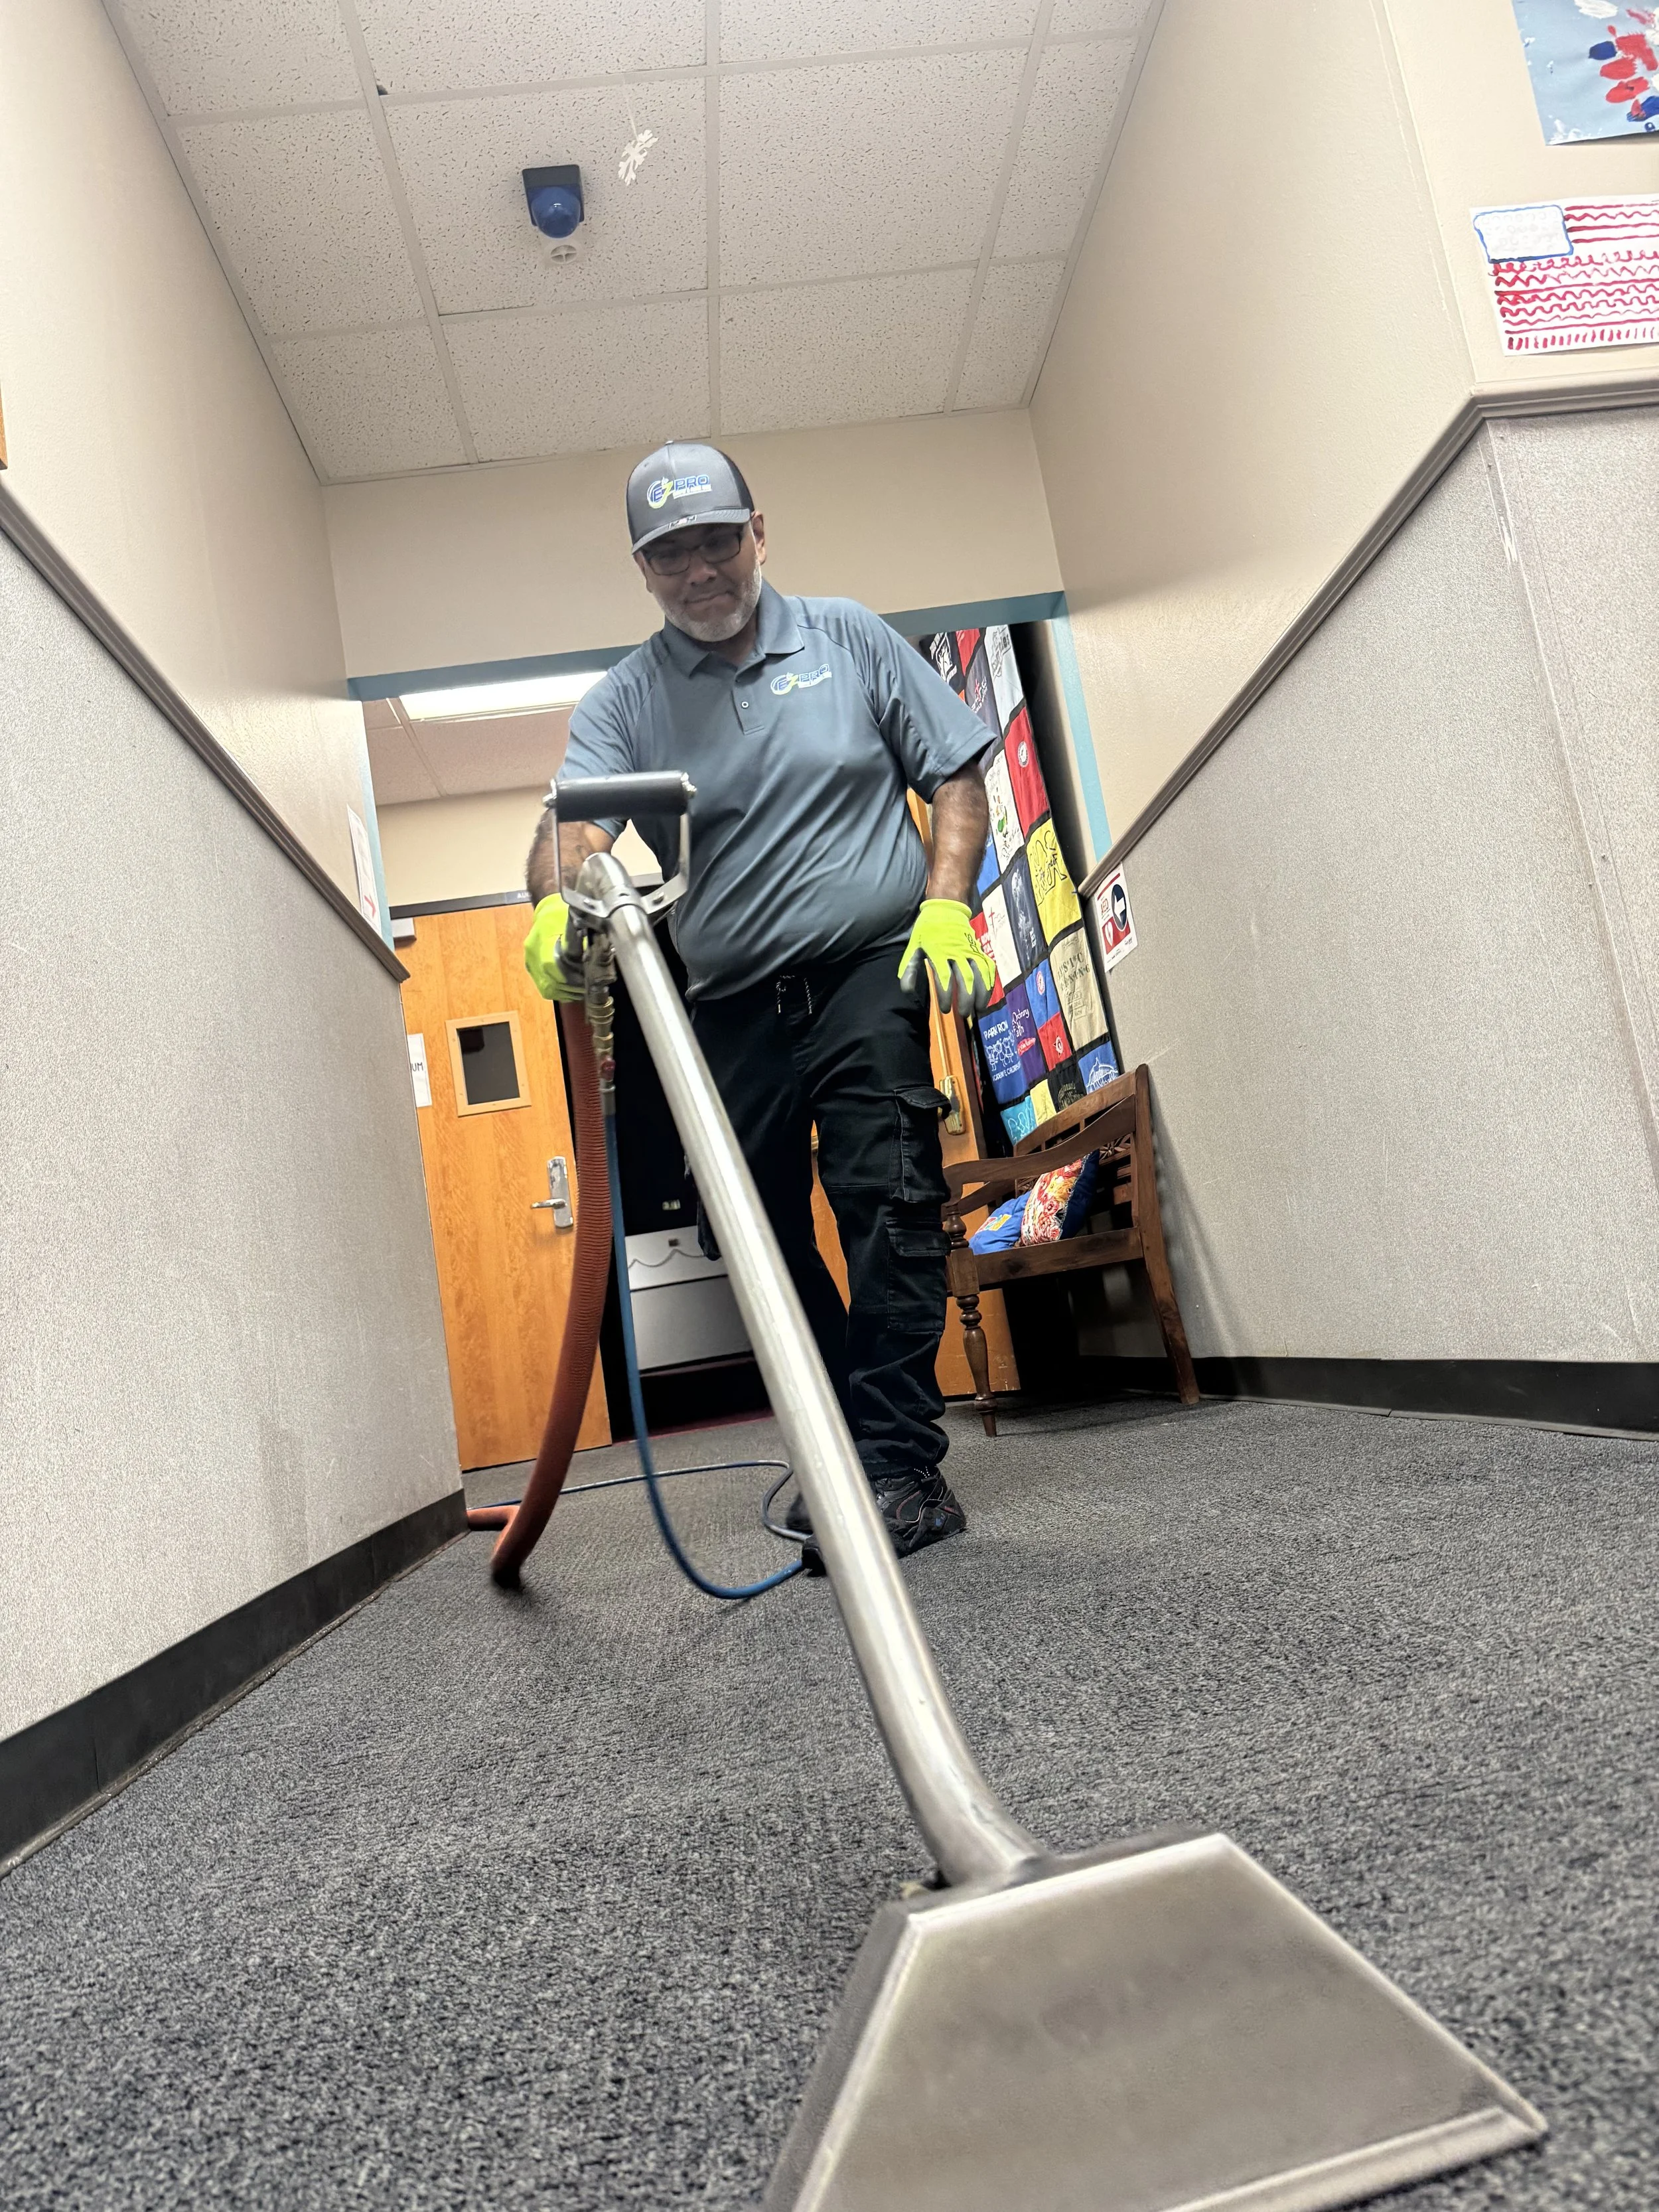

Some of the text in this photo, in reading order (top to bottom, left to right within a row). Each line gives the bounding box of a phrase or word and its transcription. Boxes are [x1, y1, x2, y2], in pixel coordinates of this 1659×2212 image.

[674, 475, 709, 492] PRO
[798, 664, 830, 682] PRO
[1100, 898, 1109, 917] AED
